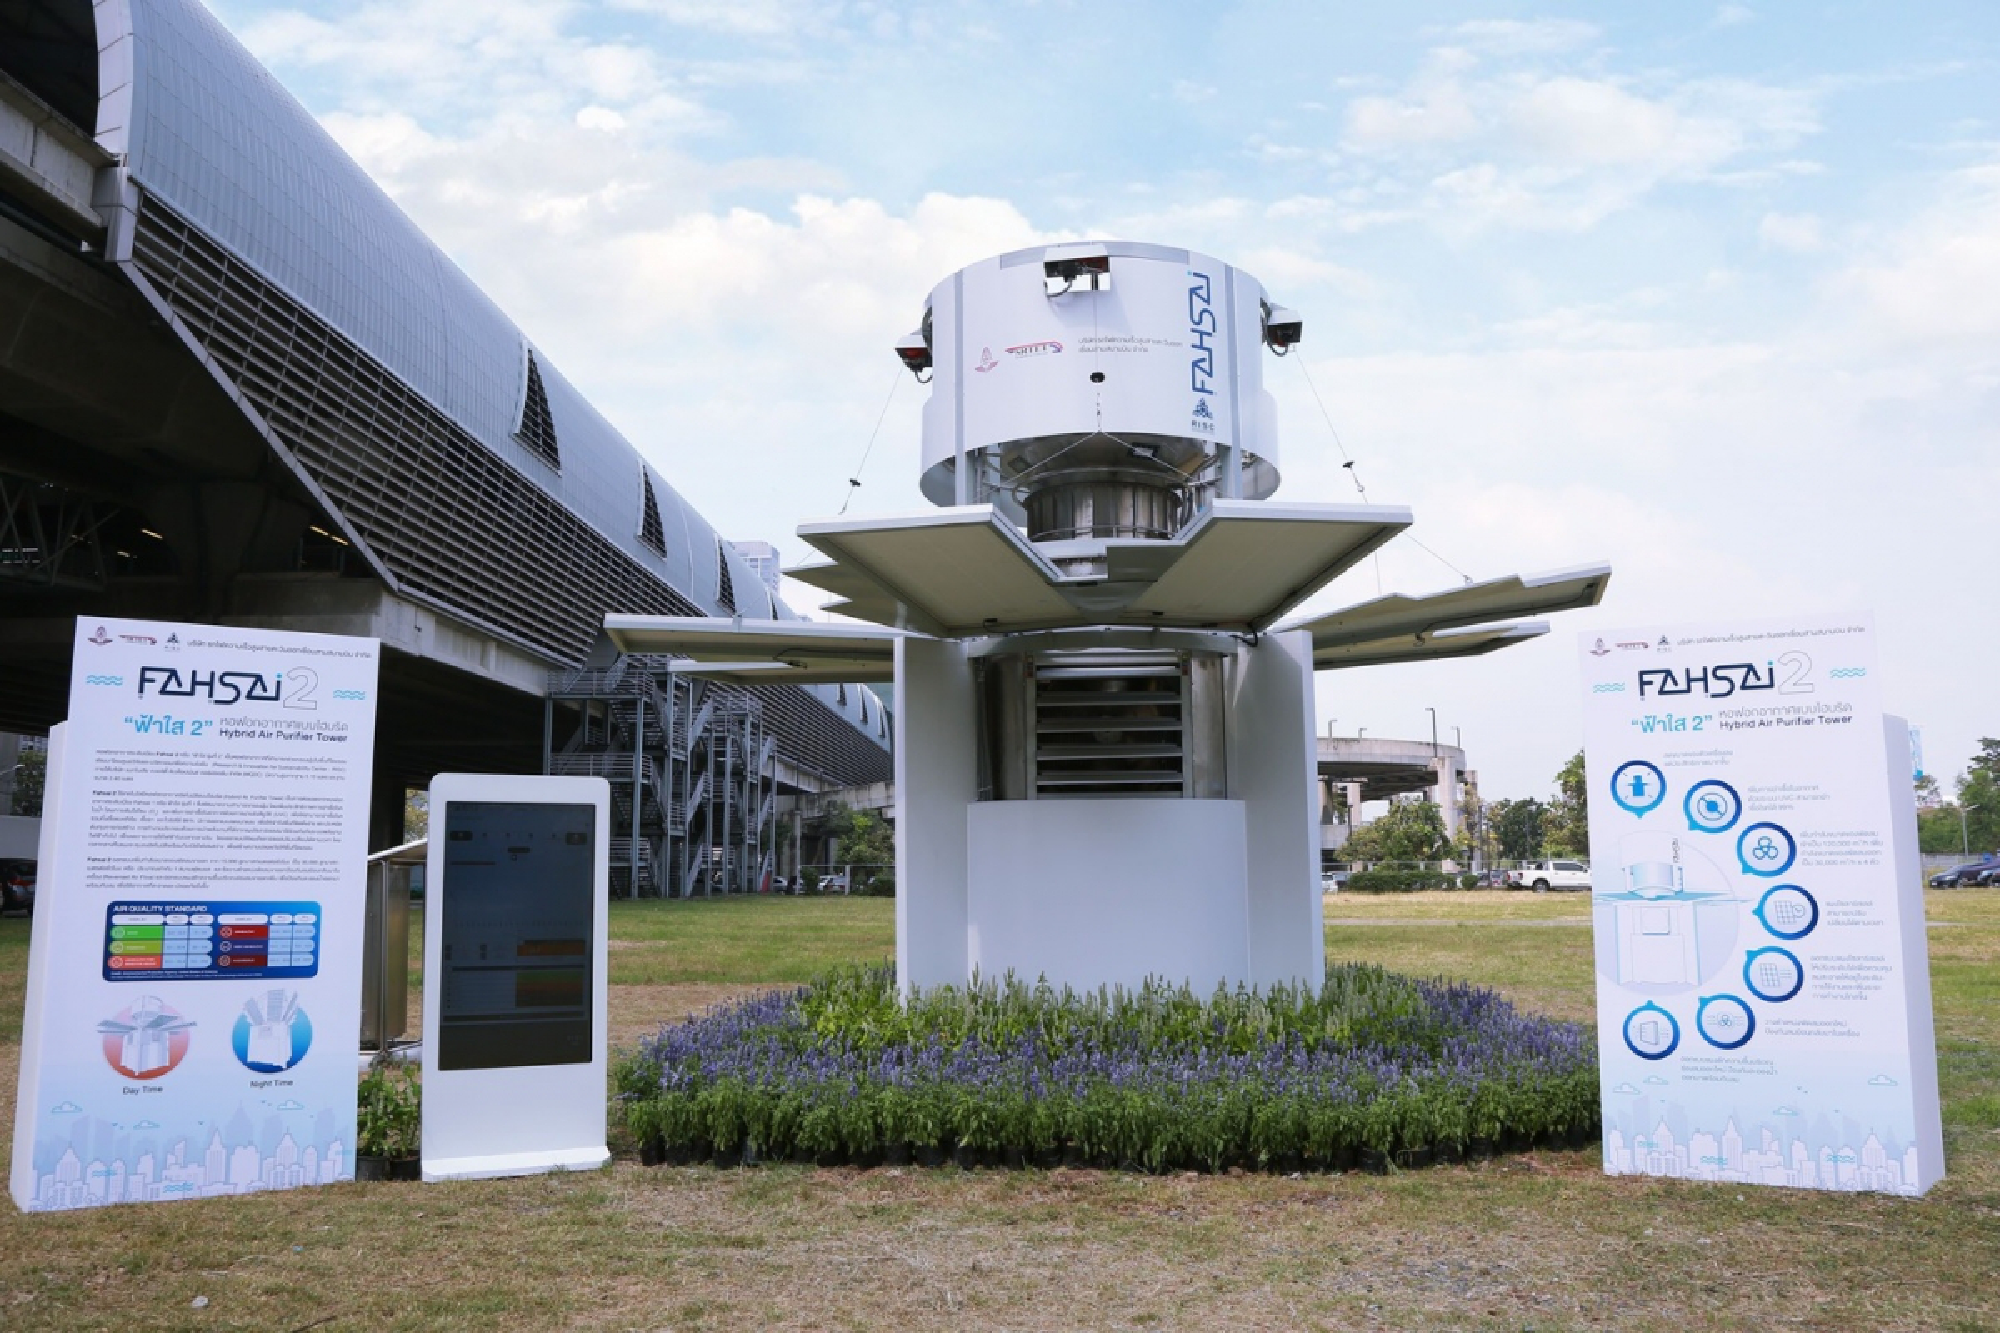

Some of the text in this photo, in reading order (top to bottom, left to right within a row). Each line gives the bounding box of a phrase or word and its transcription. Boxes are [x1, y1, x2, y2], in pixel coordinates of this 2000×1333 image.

[1719, 715, 1853, 731] Hybrid Air Purifier Tower
[219, 728, 349, 742] Hybrid Air Purifier Tower
[274, 1079, 294, 1087] Time
[142, 1085, 164, 1094] Time
